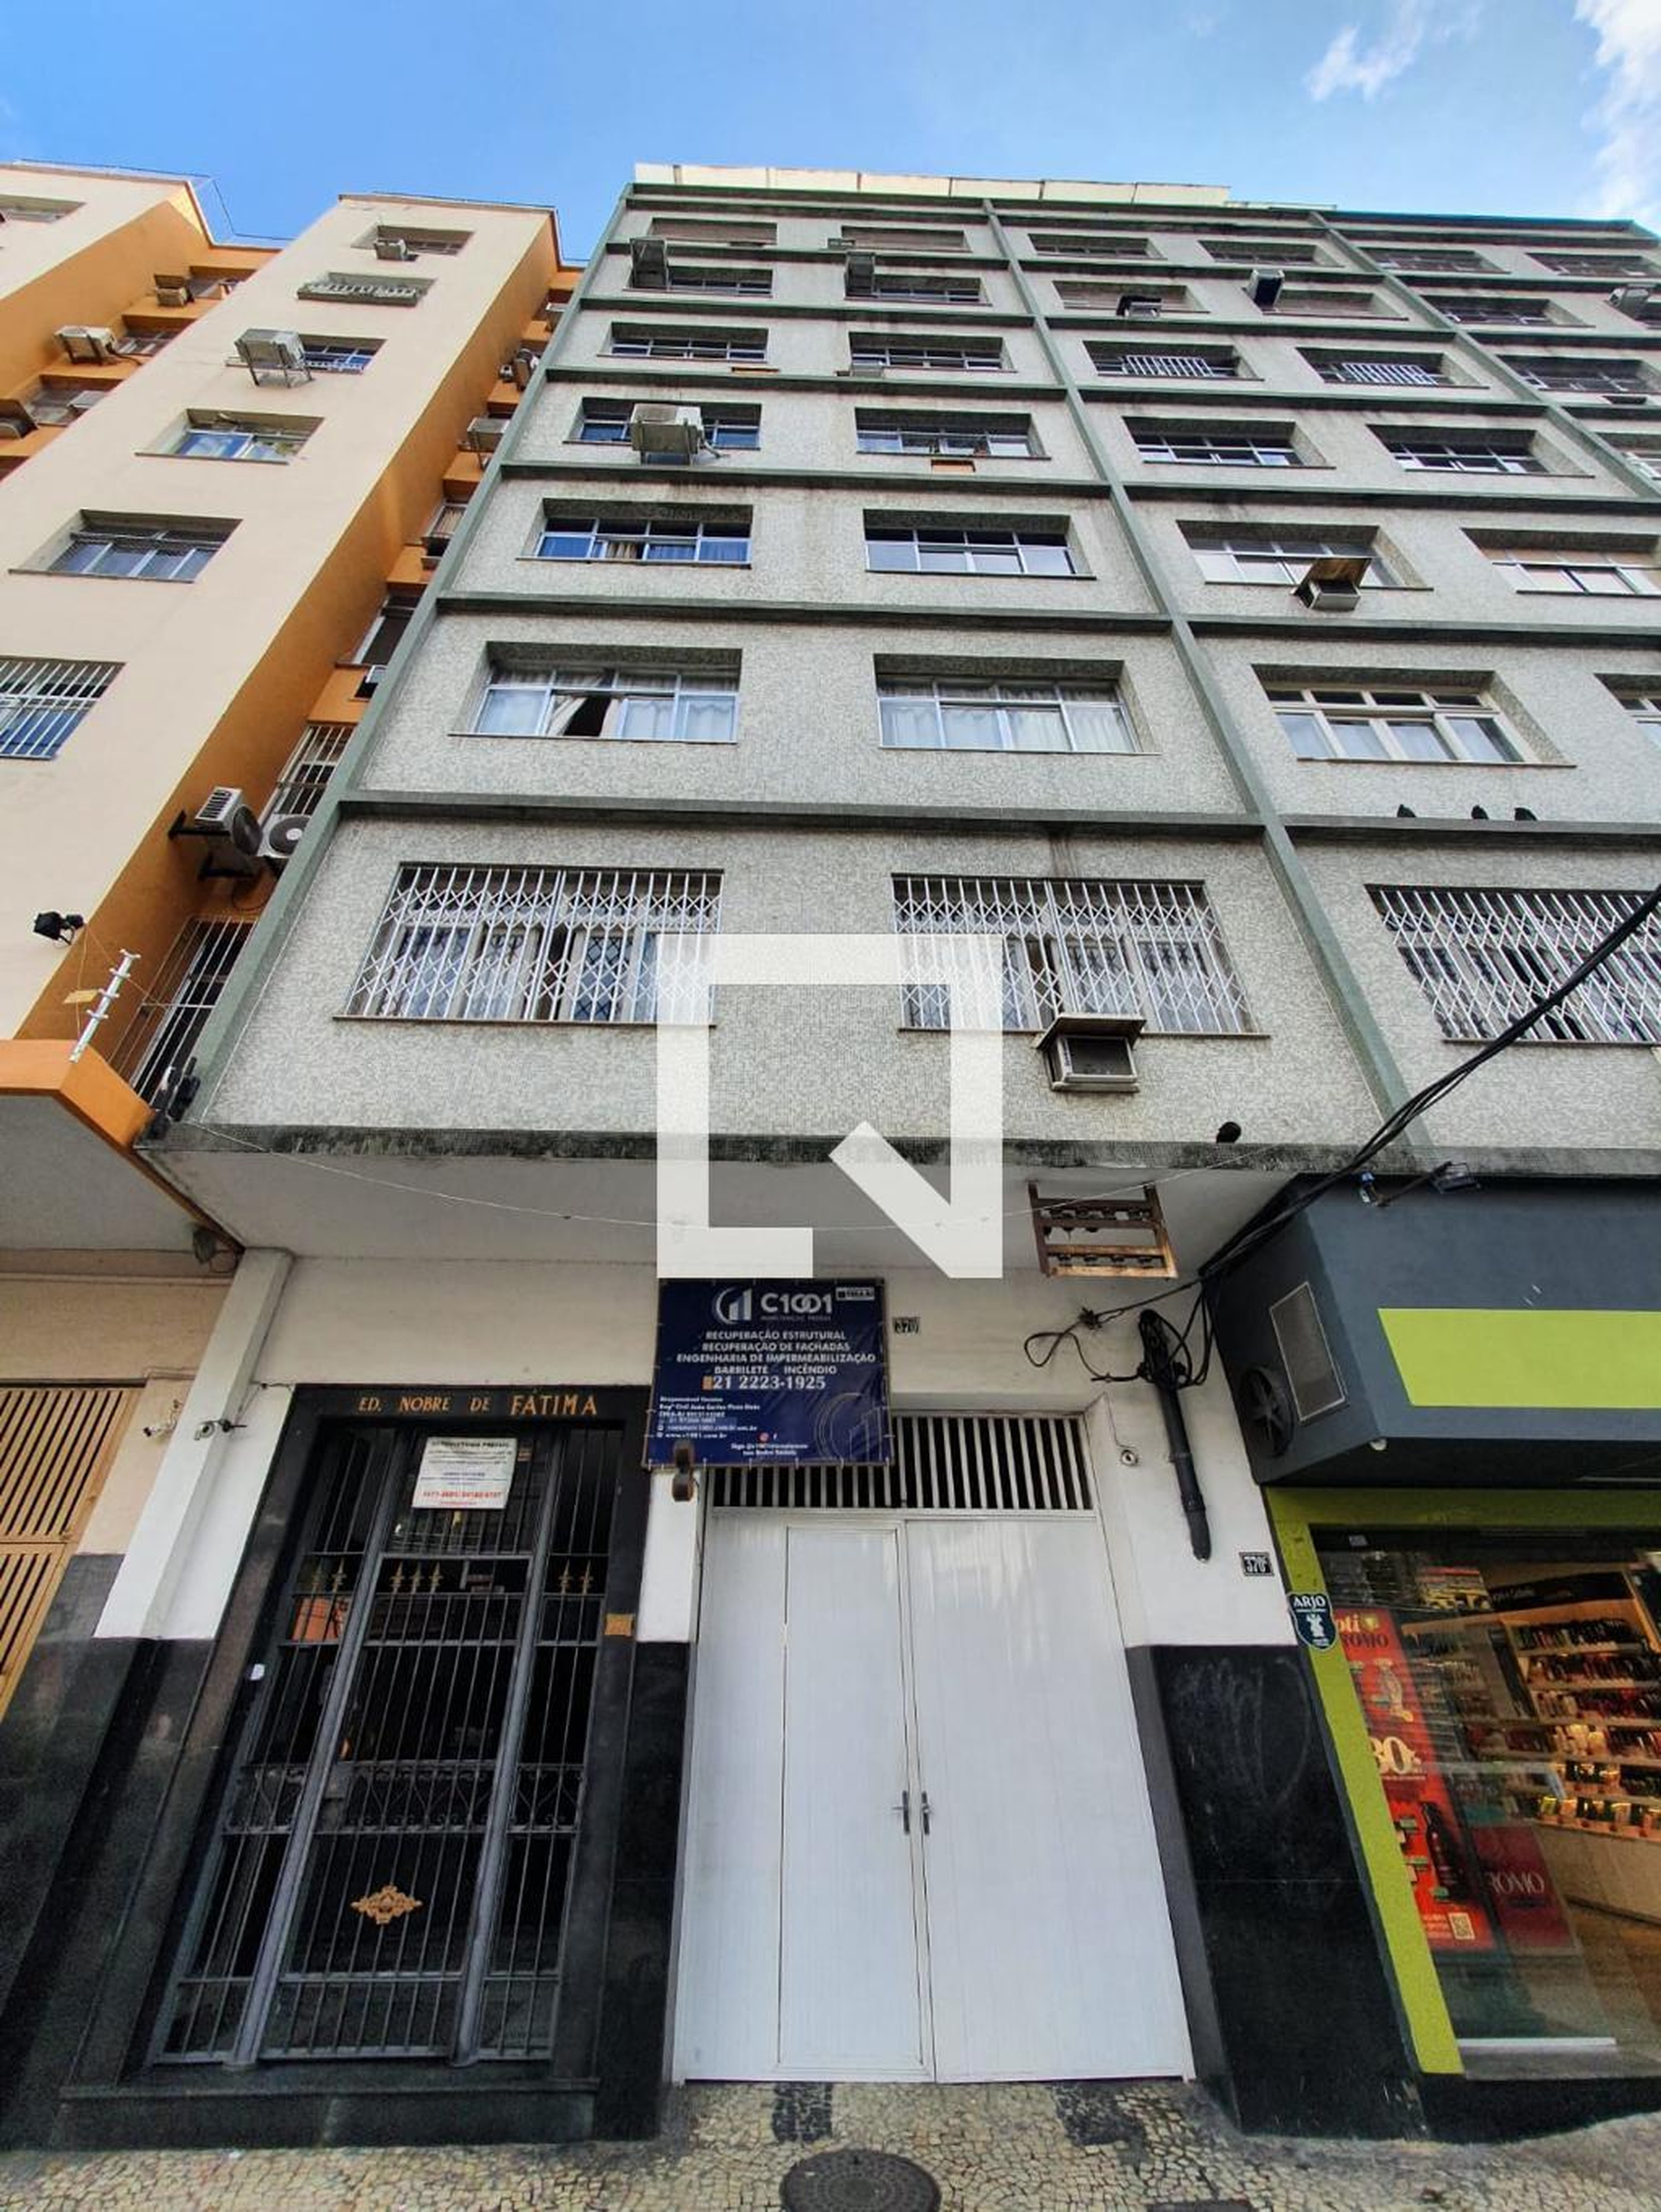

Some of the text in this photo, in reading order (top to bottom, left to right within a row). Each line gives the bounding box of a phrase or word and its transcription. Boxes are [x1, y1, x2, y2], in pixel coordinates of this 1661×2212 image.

[705, 1328, 846, 1340] RECUPERAÇÃO ESTRUTURAL
[702, 1341, 851, 1351] RECUPERAÇÃO DE FACHADAS
[676, 1353, 747, 1362] ENGENHARIA
[750, 1354, 763, 1362] DE
[715, 1363, 837, 1374] BARRILETE INCÊNDIO
[713, 1375, 826, 1389] 21 2223-1925
[358, 1397, 382, 1412] ED.
[399, 1396, 451, 1412] NOBRE
[469, 1397, 492, 1412] DE
